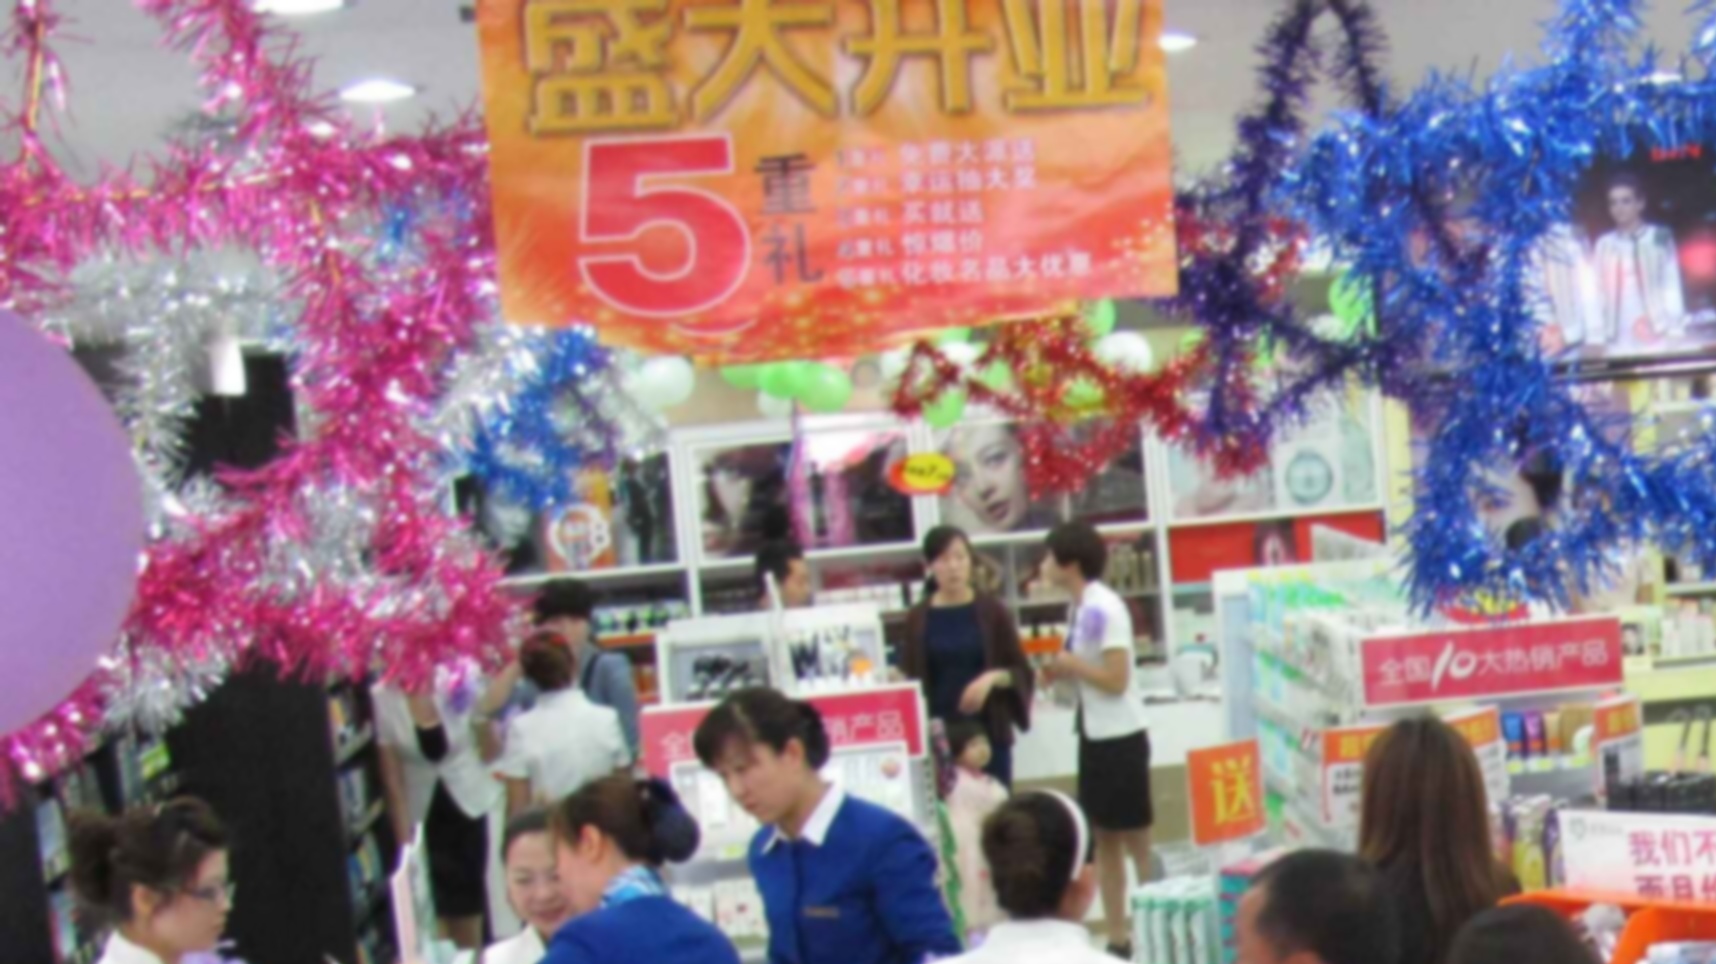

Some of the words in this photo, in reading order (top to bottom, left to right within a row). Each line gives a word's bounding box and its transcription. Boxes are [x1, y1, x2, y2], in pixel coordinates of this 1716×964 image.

[525, 0, 1148, 136] 盛大开业
[577, 132, 752, 317] 5
[753, 152, 824, 287] 重礼
[1378, 639, 1610, 693] 全国10大热销产品
[1211, 757, 1258, 826] 送
